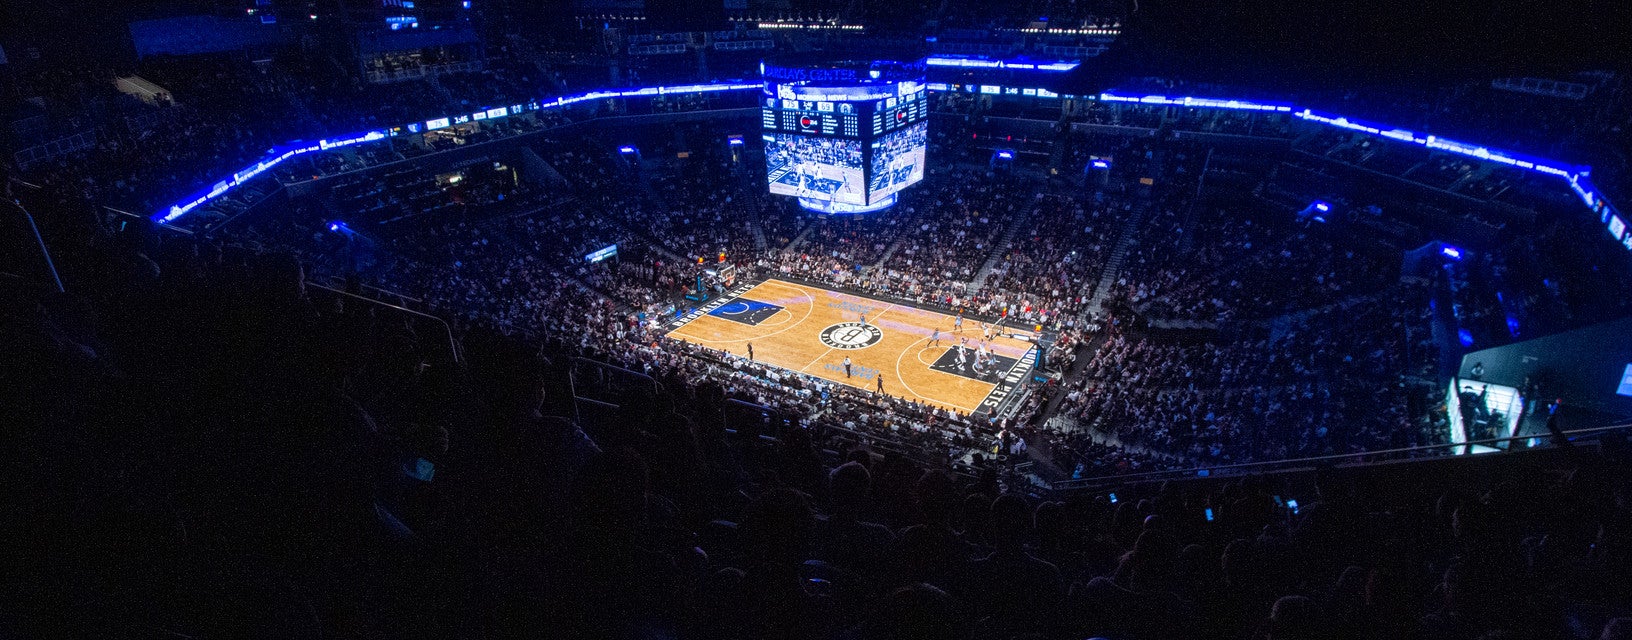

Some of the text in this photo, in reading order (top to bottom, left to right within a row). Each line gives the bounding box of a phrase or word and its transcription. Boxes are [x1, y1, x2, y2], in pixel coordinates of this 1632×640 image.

[454, 115, 469, 124] 1:46
[672, 284, 755, 326] BROOKLYN NETS
[1005, 344, 1037, 383] ROOKLYN
